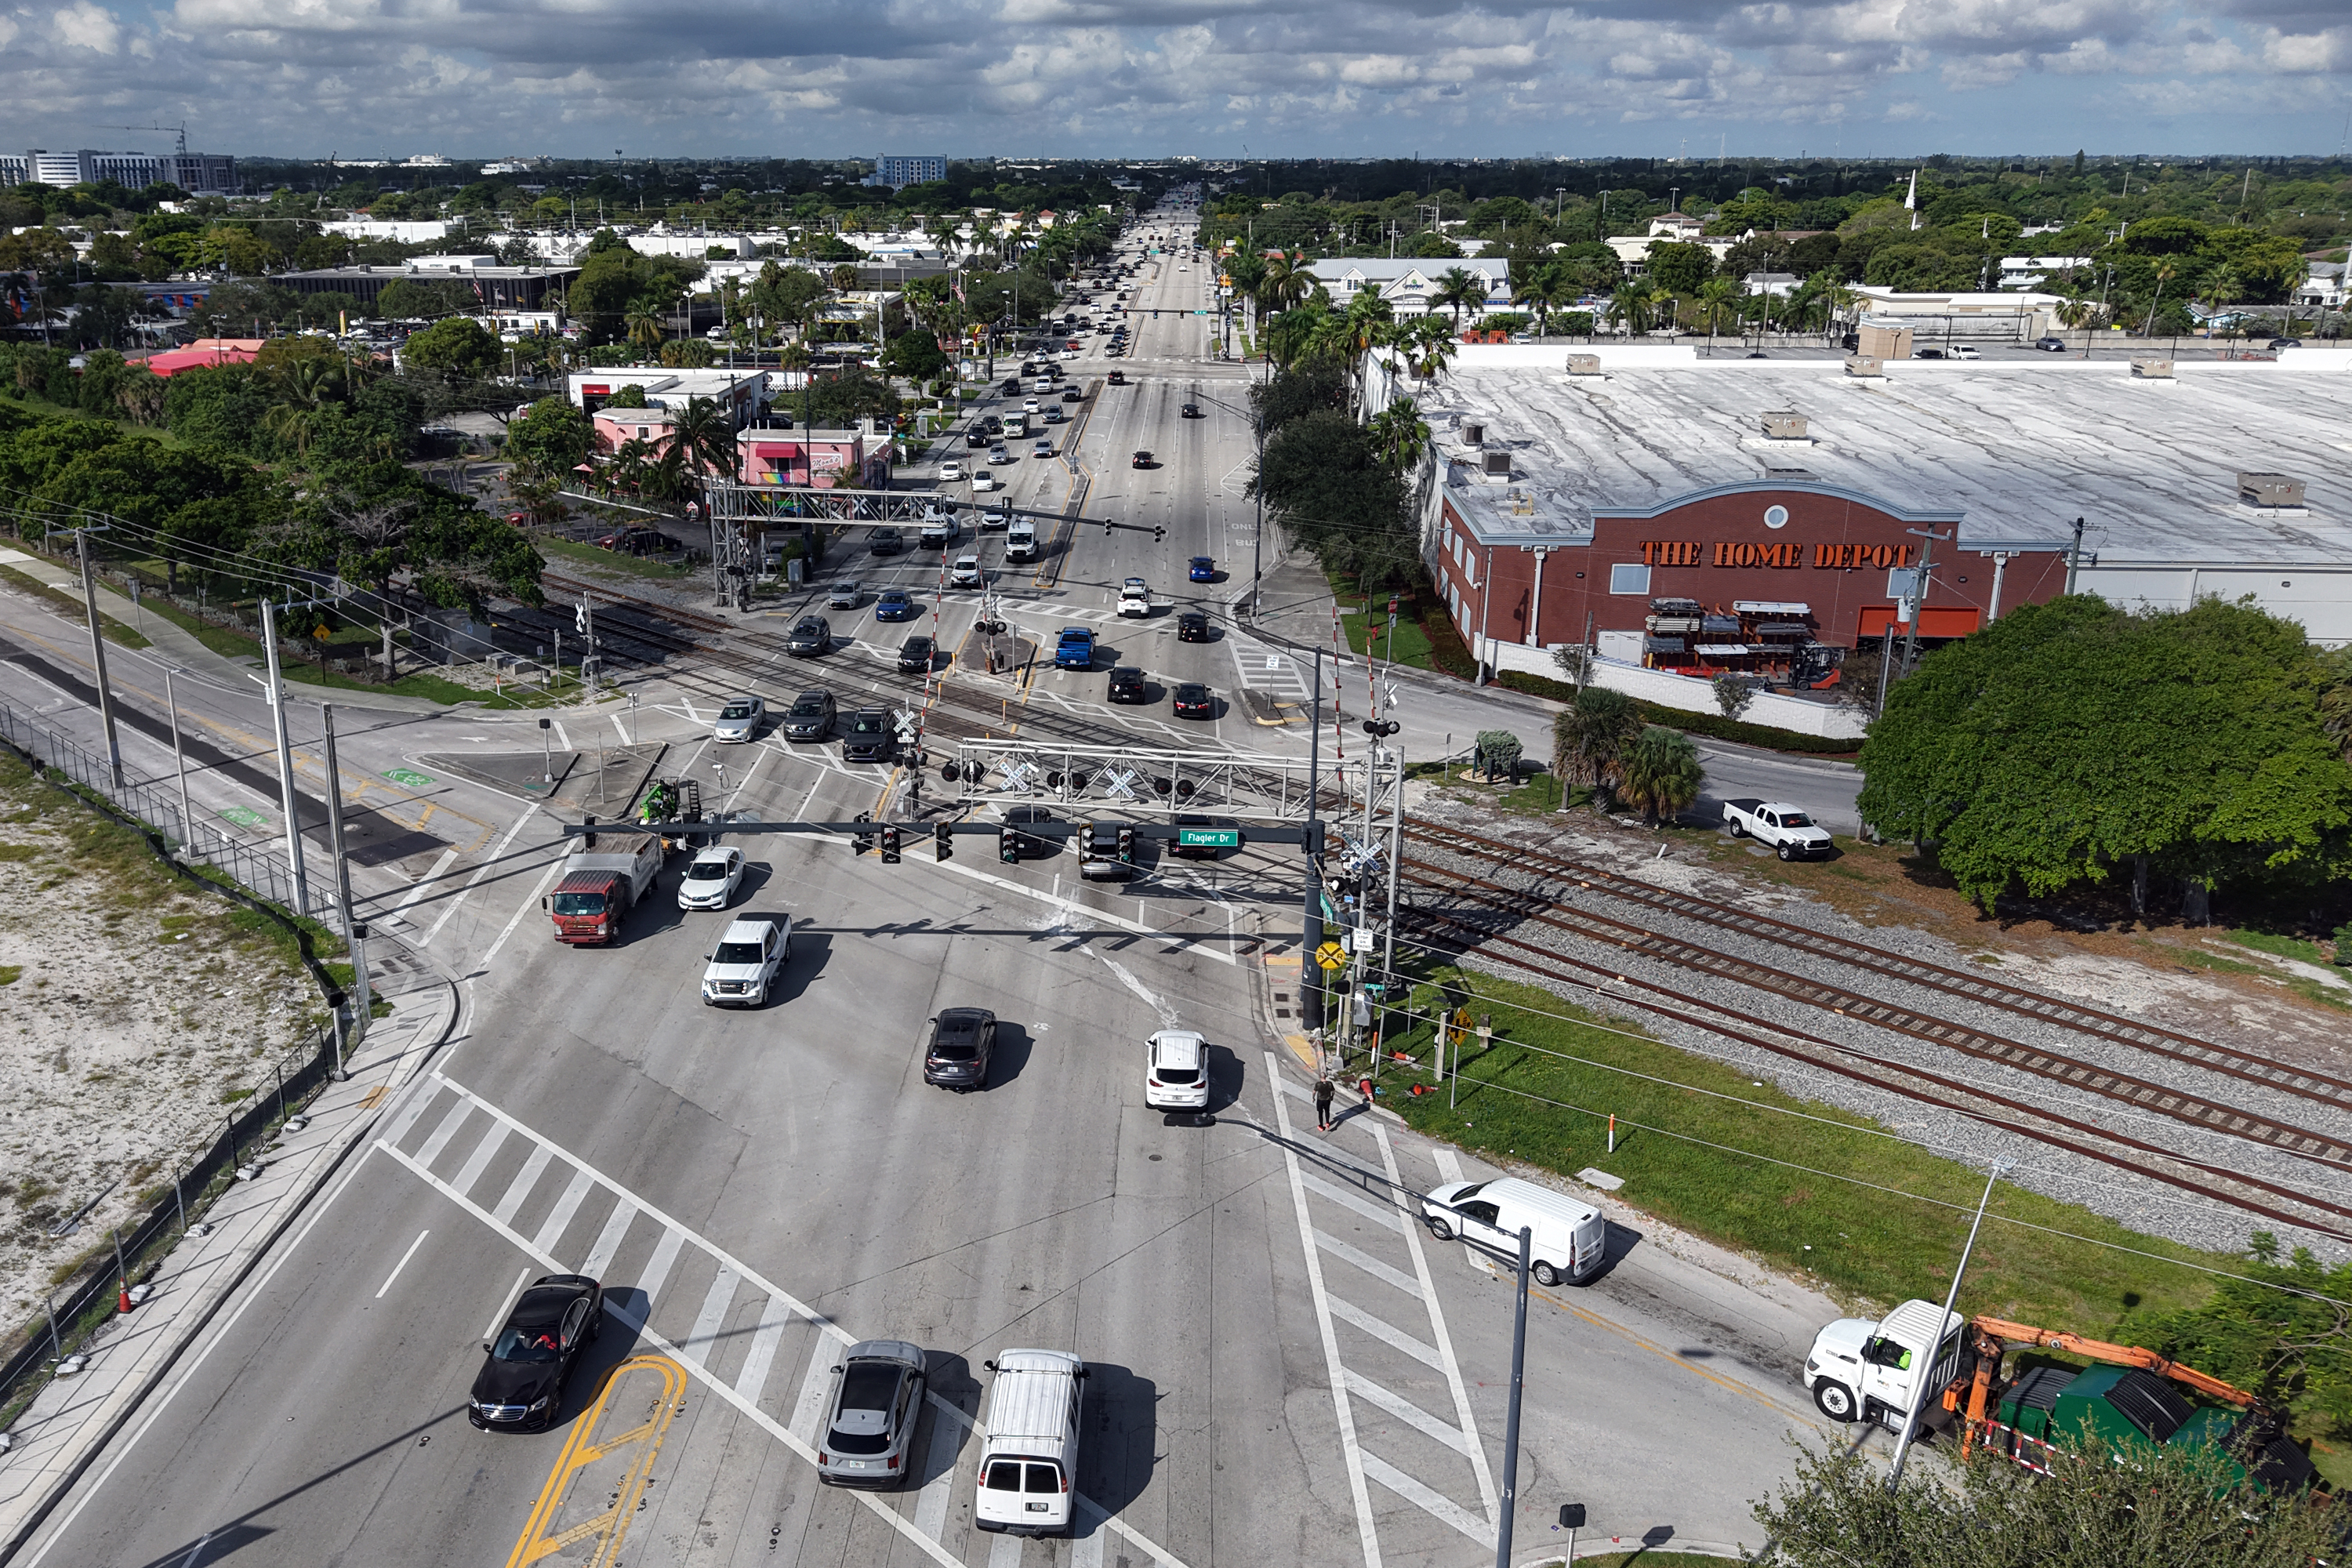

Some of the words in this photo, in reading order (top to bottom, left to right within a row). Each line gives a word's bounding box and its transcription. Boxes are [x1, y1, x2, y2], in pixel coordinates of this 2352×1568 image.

[811, 456, 840, 468] Mona's
[1639, 540, 1704, 567] THE
[1712, 542, 1804, 568] HOME
[1813, 543, 1915, 570] DEPOT
[1001, 763, 1012, 776] RAIL
[1015, 778, 1028, 790] ROAD
[1001, 764, 1027, 790] CROSSING
[1106, 771, 1134, 797] CROSSING
[1107, 769, 1119, 783] RAIL
[1122, 785, 1134, 797] ROAD
[1188, 833, 1216, 844] Flagler
[1353, 843, 1366, 855] RAIL
[1367, 858, 1380, 870] ROAD
